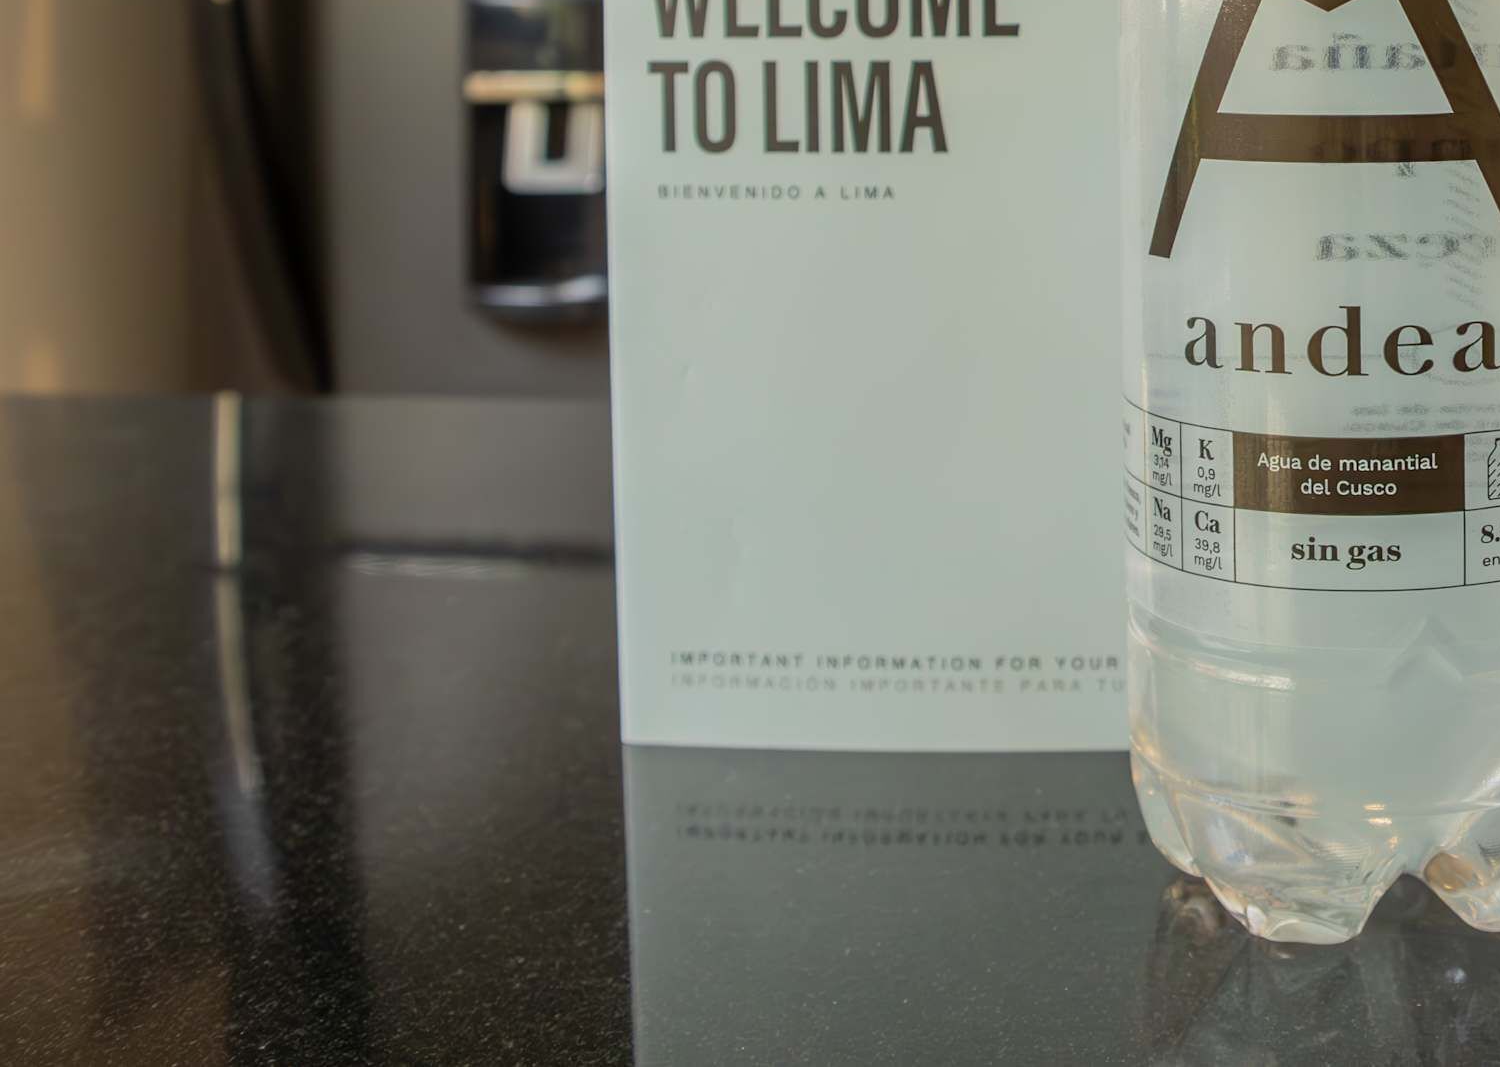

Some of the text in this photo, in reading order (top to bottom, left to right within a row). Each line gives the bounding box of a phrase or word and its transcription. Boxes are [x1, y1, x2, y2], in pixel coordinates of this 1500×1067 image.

[647, 60, 949, 154] TO LIMA
[657, 184, 896, 200] BIENVENIDO A LIMA
[1151, 425, 1173, 458] Mg
[1198, 438, 1215, 461] K
[1257, 452, 1438, 472] Agua de manantial
[1152, 470, 1172, 487] mg/l
[1197, 466, 1216, 481] 0,9
[1193, 482, 1222, 498] mg/l
[1300, 478, 1398, 496] del Cusco
[1153, 496, 1172, 522] Na
[1194, 510, 1222, 534] Ca
[1153, 540, 1173, 558] mg/l
[1194, 538, 1220, 554] 39,8
[1291, 536, 1402, 571] sin gas
[1194, 554, 1222, 571] mg/l
[1482, 554, 1500, 567] en
[670, 651, 1119, 671] IMPORTANT INFORMATION FOR YOUR
